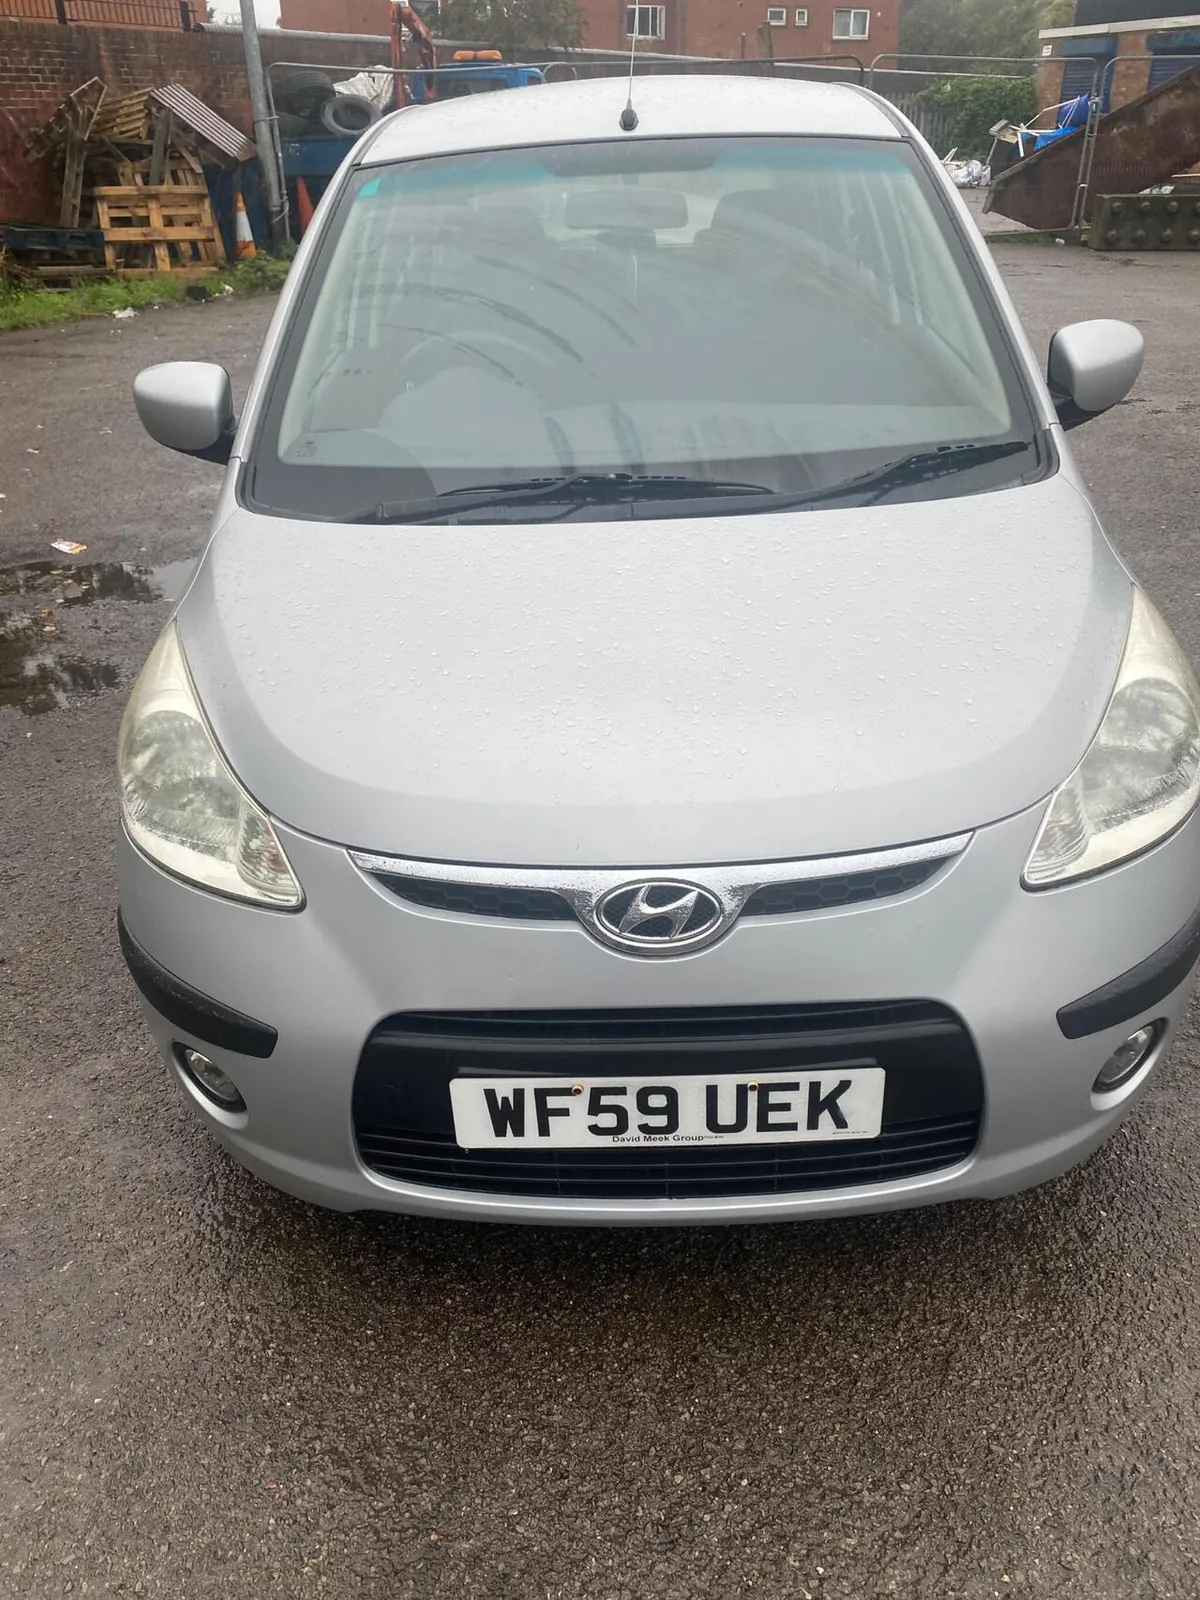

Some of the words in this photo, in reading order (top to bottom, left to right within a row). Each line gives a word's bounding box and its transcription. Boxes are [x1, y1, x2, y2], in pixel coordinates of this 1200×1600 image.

[483, 1085, 679, 1138] WF59
[705, 1079, 853, 1134] UEK
[612, 1135, 640, 1143] David
[672, 1134, 704, 1142] Group
